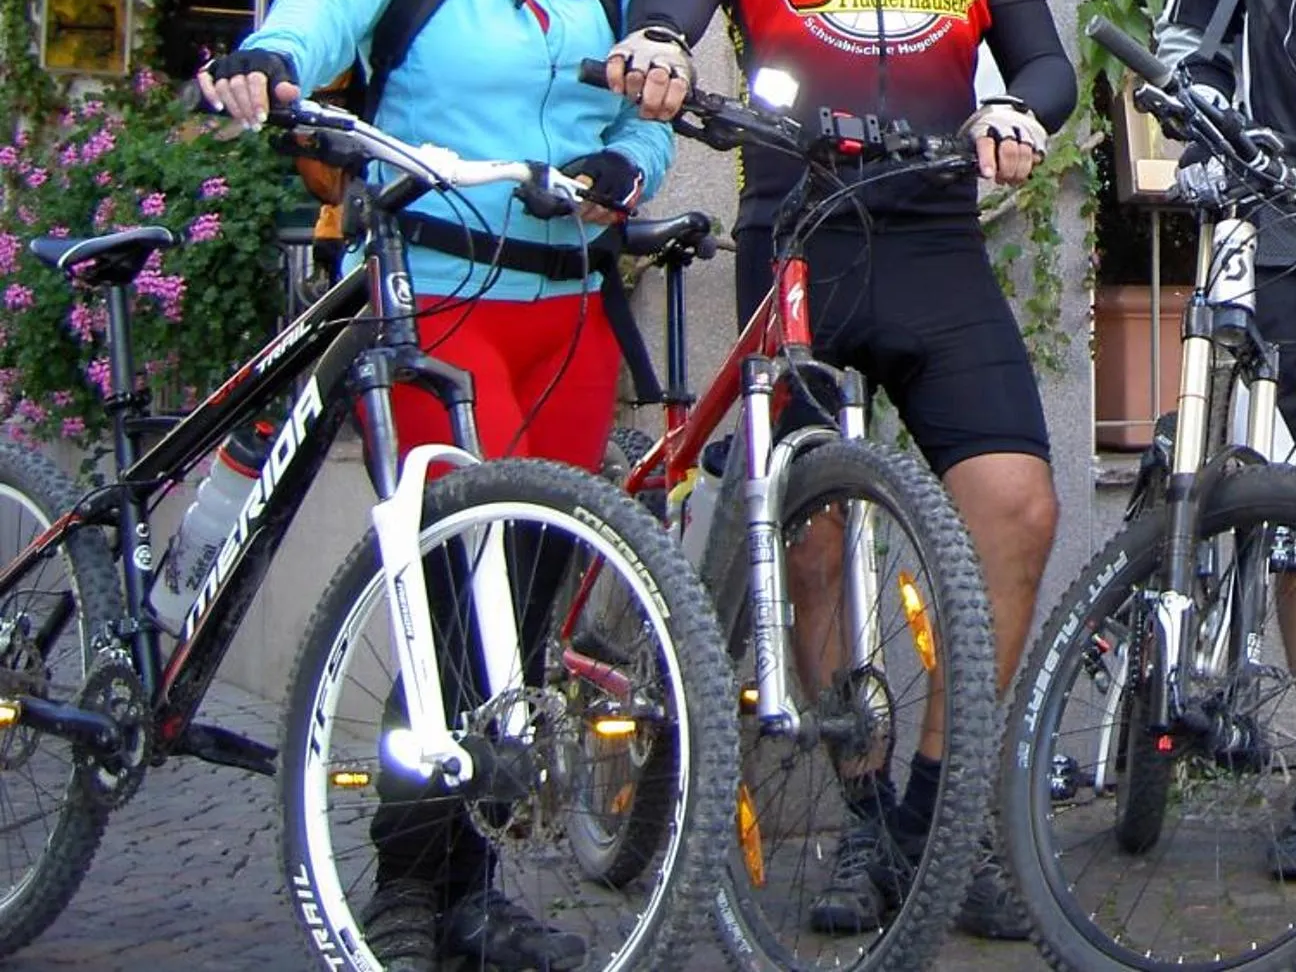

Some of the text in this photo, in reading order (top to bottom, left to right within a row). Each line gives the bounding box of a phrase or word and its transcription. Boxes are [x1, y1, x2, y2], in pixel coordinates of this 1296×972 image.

[256, 321, 312, 372] TRAIL
[185, 374, 323, 639] MERIDA
[1023, 611, 1080, 733] ALBERT
[291, 863, 344, 972] TRAIL
